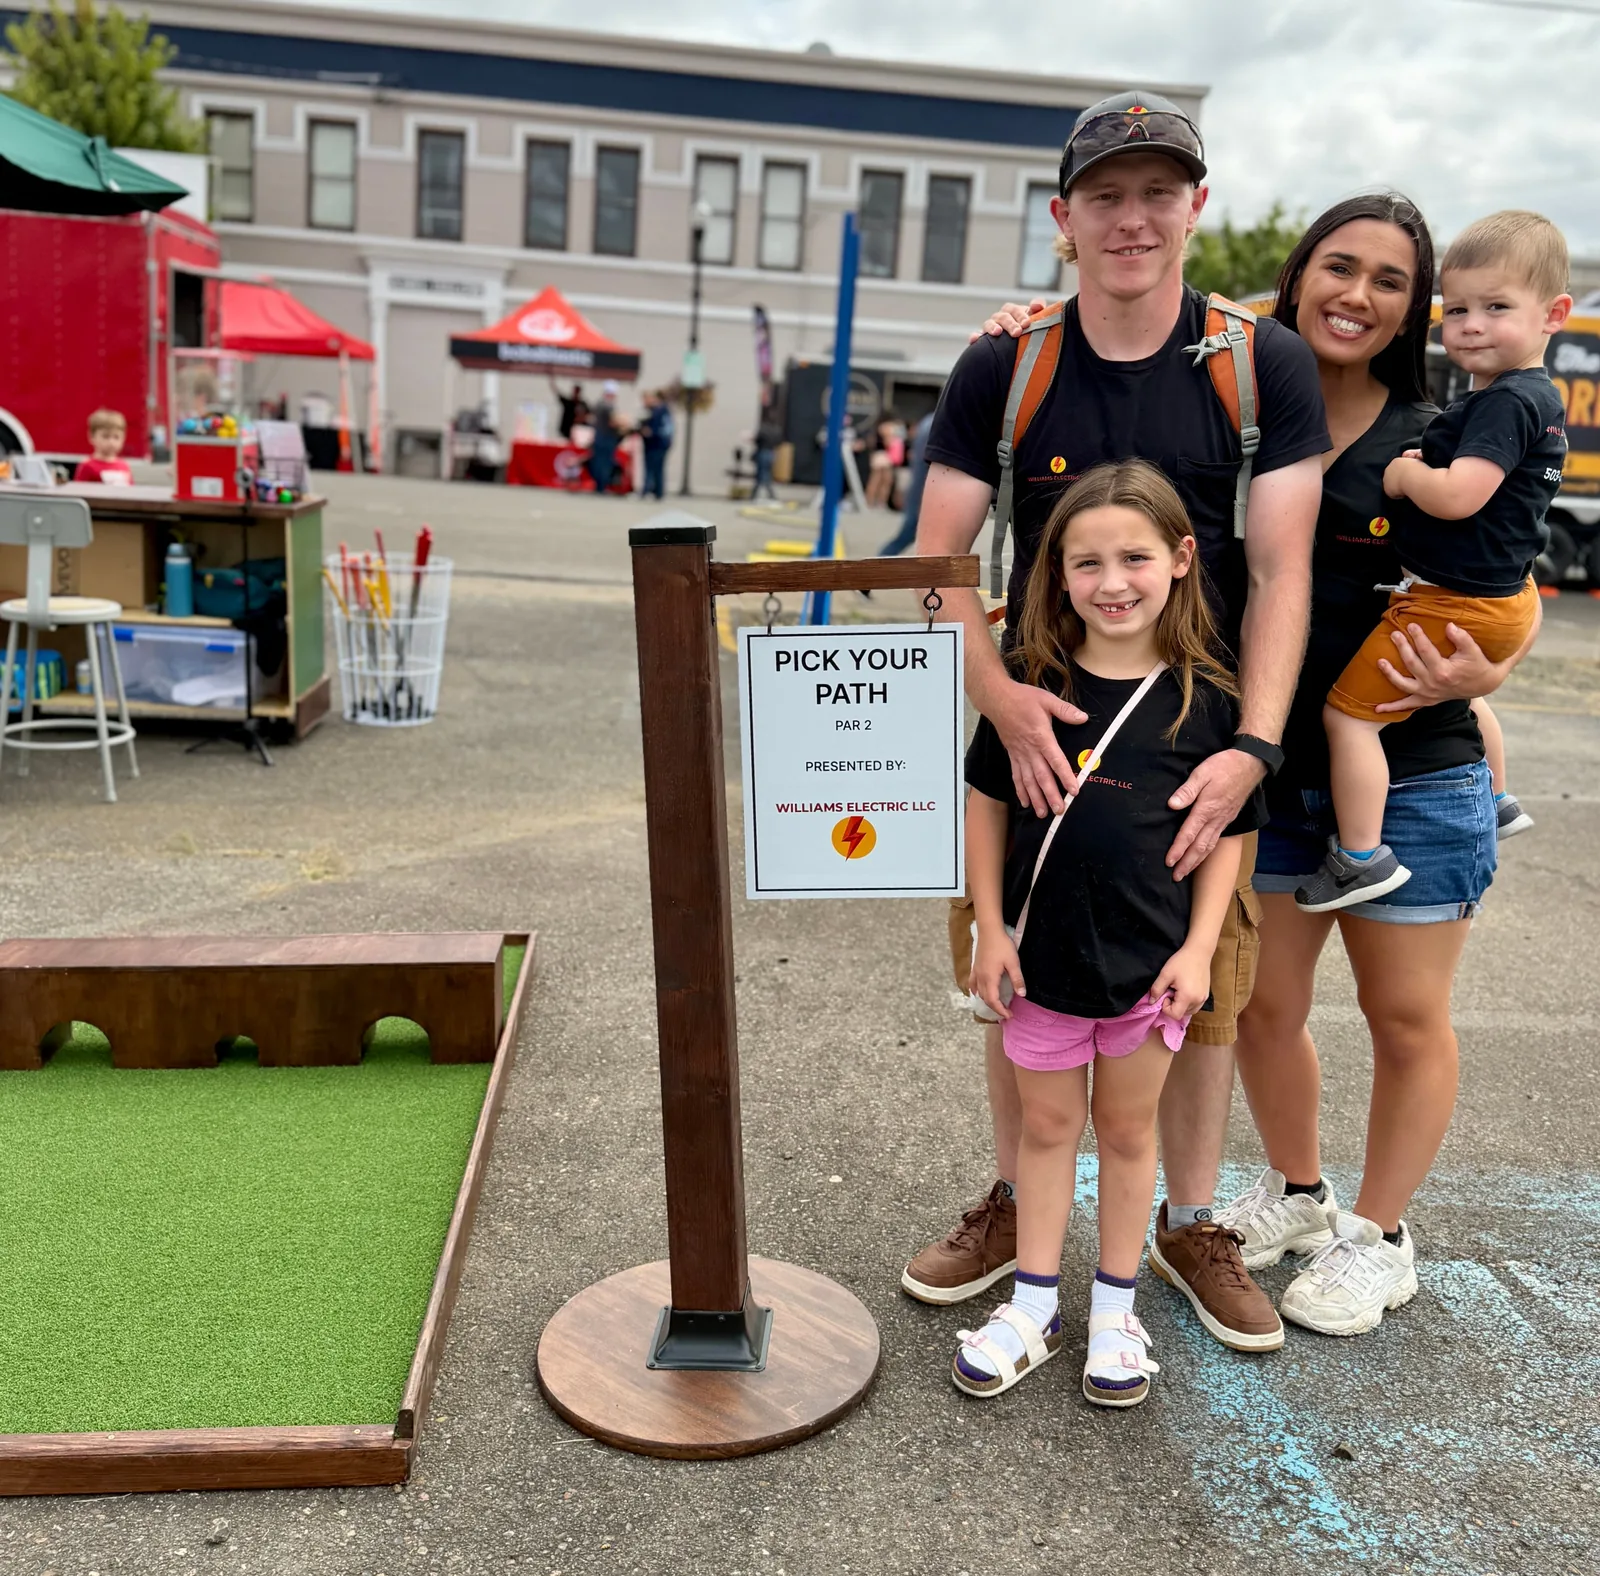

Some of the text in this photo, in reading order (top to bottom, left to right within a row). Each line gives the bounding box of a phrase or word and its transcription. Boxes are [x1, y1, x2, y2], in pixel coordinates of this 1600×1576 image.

[1543, 467, 1562, 482] 503-
[1336, 534, 1371, 544] WILLIAMS
[775, 648, 928, 672] PICK YOUR
[815, 682, 888, 705] PATH
[835, 719, 872, 731] PAR 2
[805, 760, 906, 772] PRESENTED BY:
[1086, 775, 1117, 786] ECTRIC
[1117, 780, 1133, 790] LLC
[775, 801, 936, 813] WILLIAMS ELECTRIC LLC
